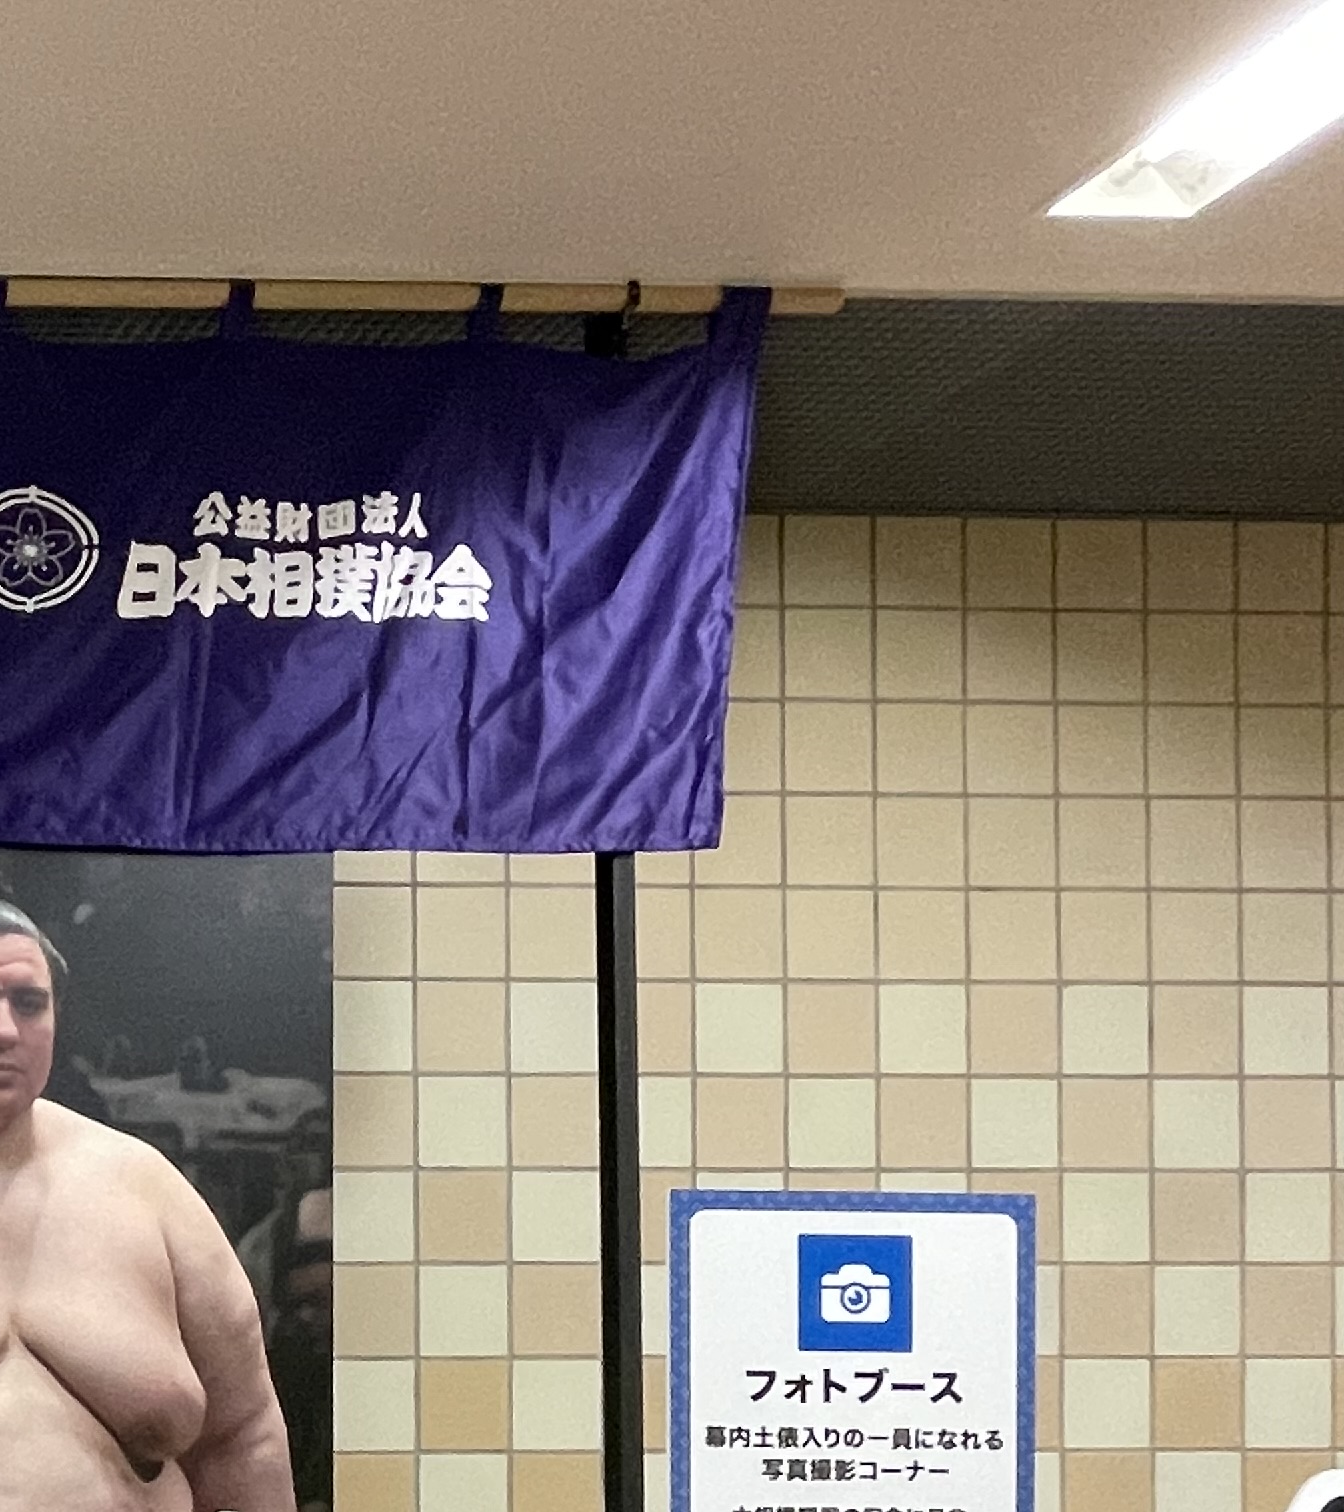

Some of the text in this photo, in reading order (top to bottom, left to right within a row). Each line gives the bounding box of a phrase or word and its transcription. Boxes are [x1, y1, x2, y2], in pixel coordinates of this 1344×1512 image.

[193, 490, 428, 543] 公益財団法人
[117, 541, 493, 623] 日本相撲協会
[746, 1368, 963, 1404] フォトブース
[705, 1425, 1004, 1451] 幕内土俵入りの一員になれる
[762, 1458, 950, 1482] 写真撮影コーナー
